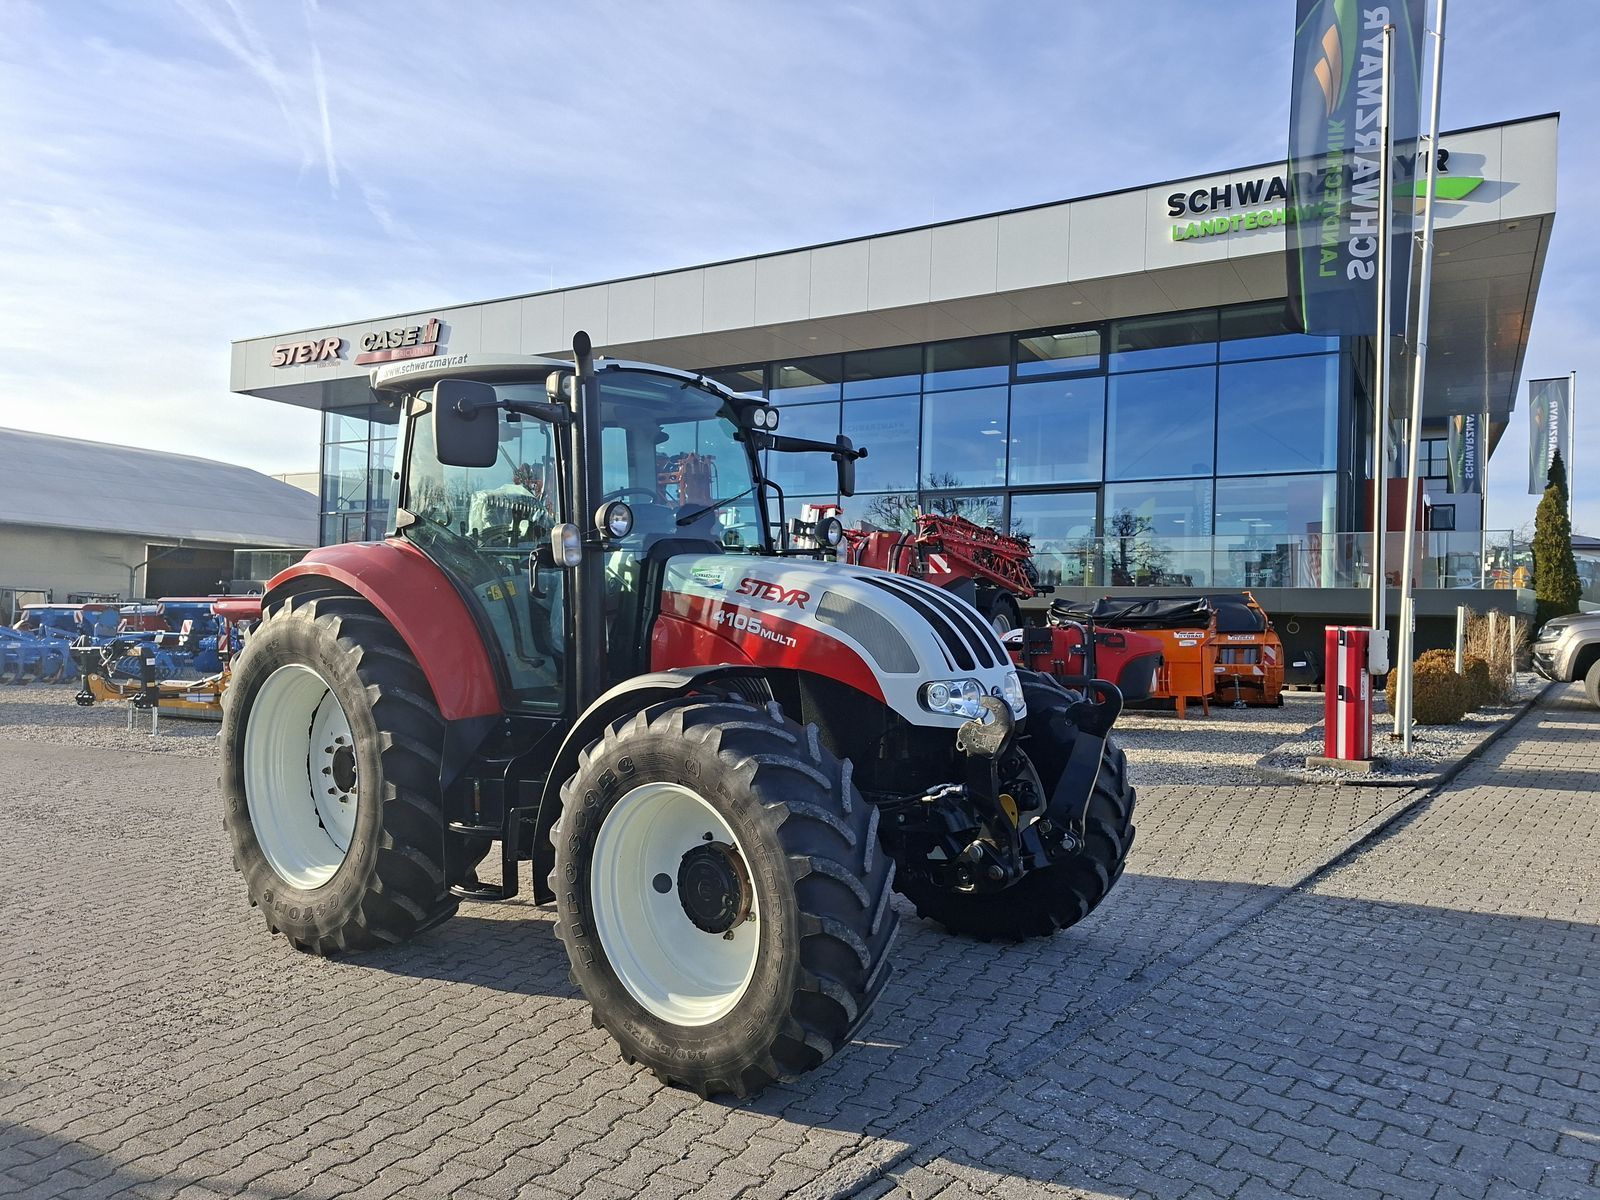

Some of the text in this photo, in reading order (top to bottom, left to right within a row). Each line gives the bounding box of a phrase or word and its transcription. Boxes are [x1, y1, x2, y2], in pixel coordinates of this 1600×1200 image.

[1167, 148, 1450, 218] SCHWARYR
[1172, 202, 1326, 242] LANDTECH
[270, 336, 342, 367] STEYR
[360, 326, 420, 352] CASE
[735, 577, 811, 610] STEYR
[713, 609, 797, 648] 4105 MULTI
